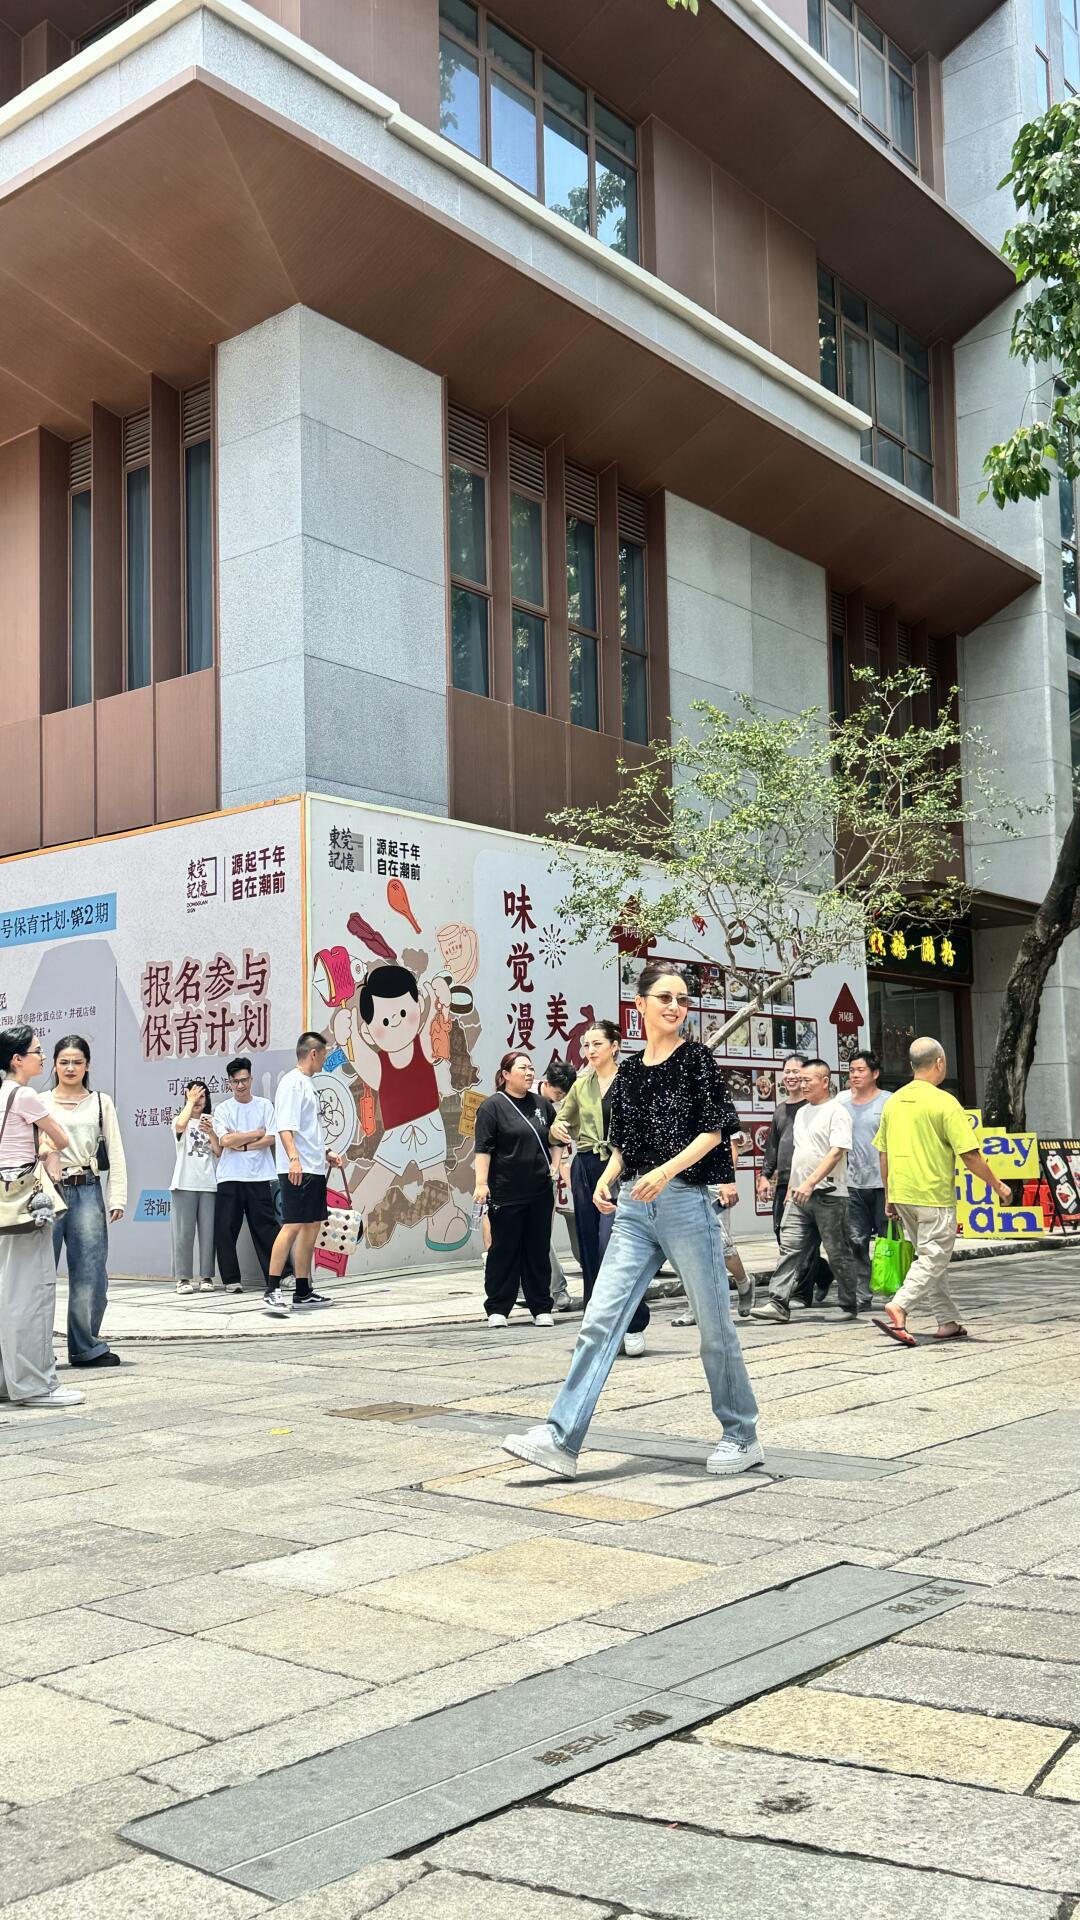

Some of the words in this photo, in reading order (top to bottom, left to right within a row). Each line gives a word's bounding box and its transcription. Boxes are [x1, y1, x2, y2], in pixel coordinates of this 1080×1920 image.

[231, 845, 285, 875] 源起千年
[377, 838, 420, 861] 源起千年
[377, 858, 420, 881] 自在潮前
[231, 870, 286, 901] 自在潮前
[143, 953, 268, 1008] 报名参与
[503, 883, 537, 1051] 味觉漫
[142, 1004, 268, 1058] 保育计划
[144, 1198, 171, 1217] 咨询
[969, 1206, 1043, 1233] an
